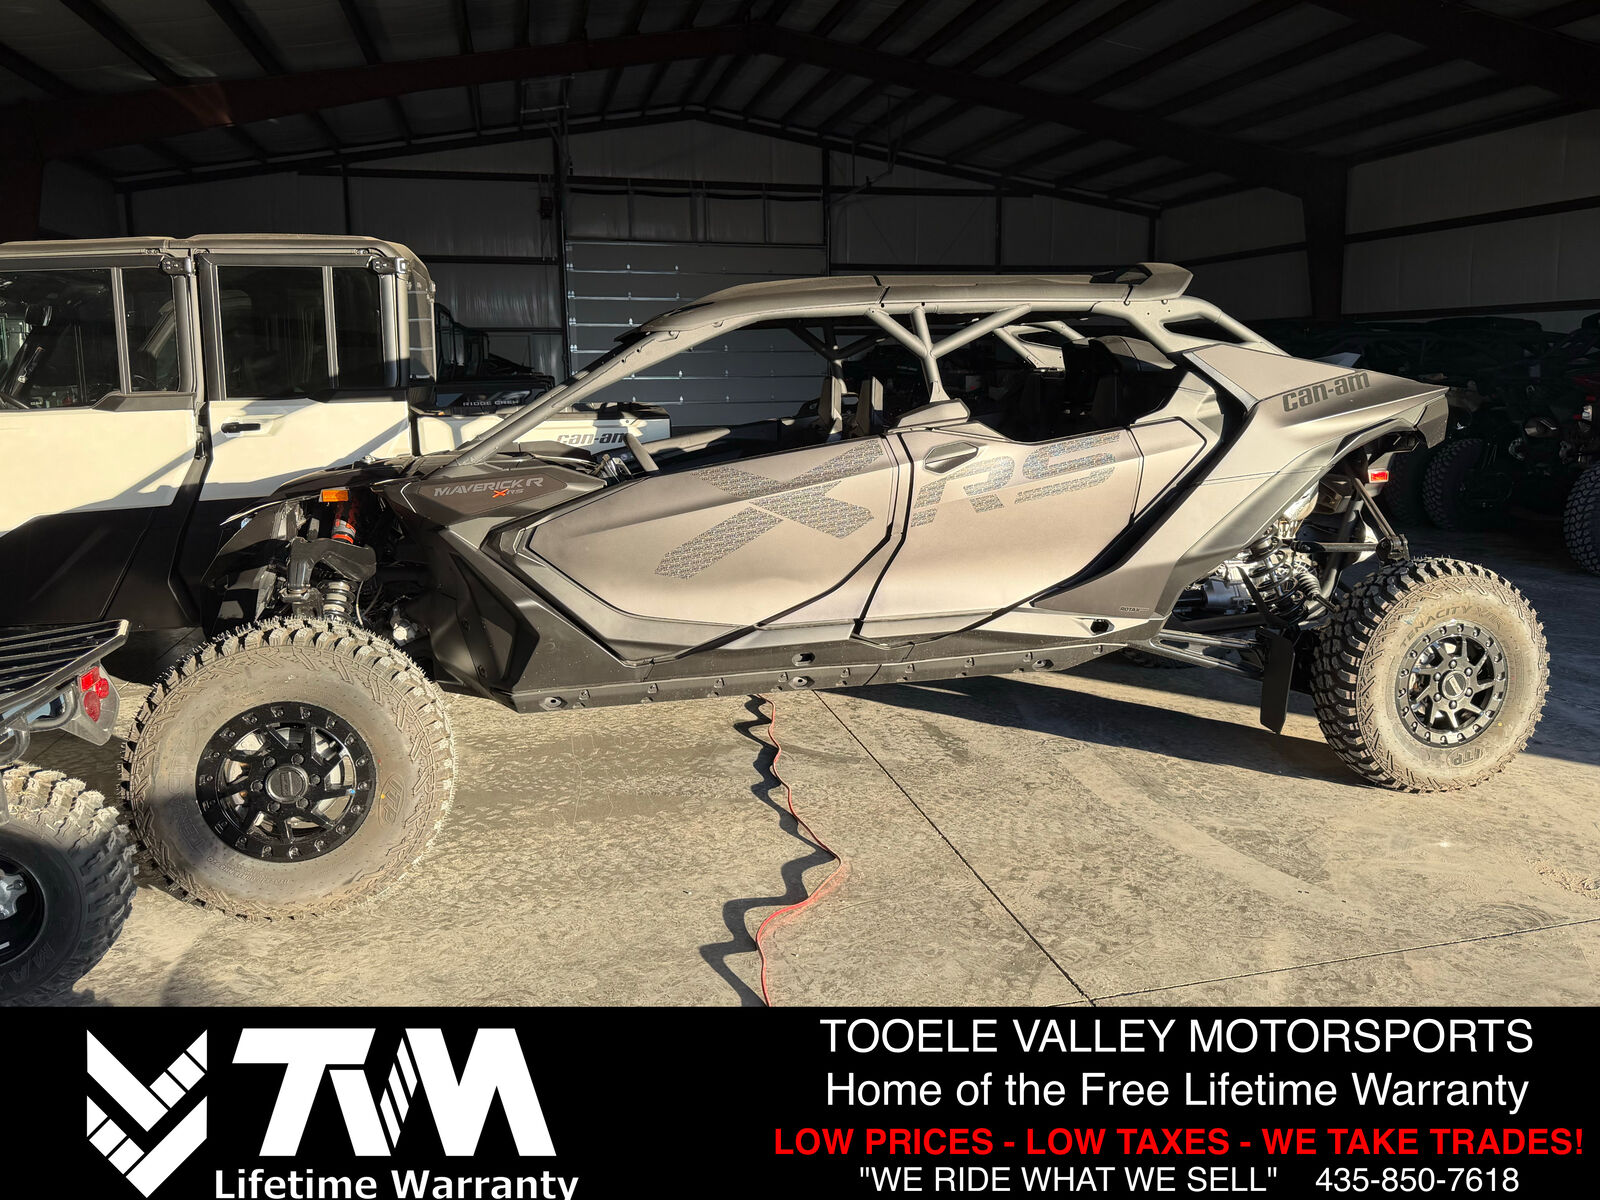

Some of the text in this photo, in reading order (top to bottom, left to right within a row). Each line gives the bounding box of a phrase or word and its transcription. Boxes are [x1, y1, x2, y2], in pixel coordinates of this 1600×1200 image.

[1282, 372, 1370, 412] can-am
[433, 477, 544, 497] MAVERICK R
